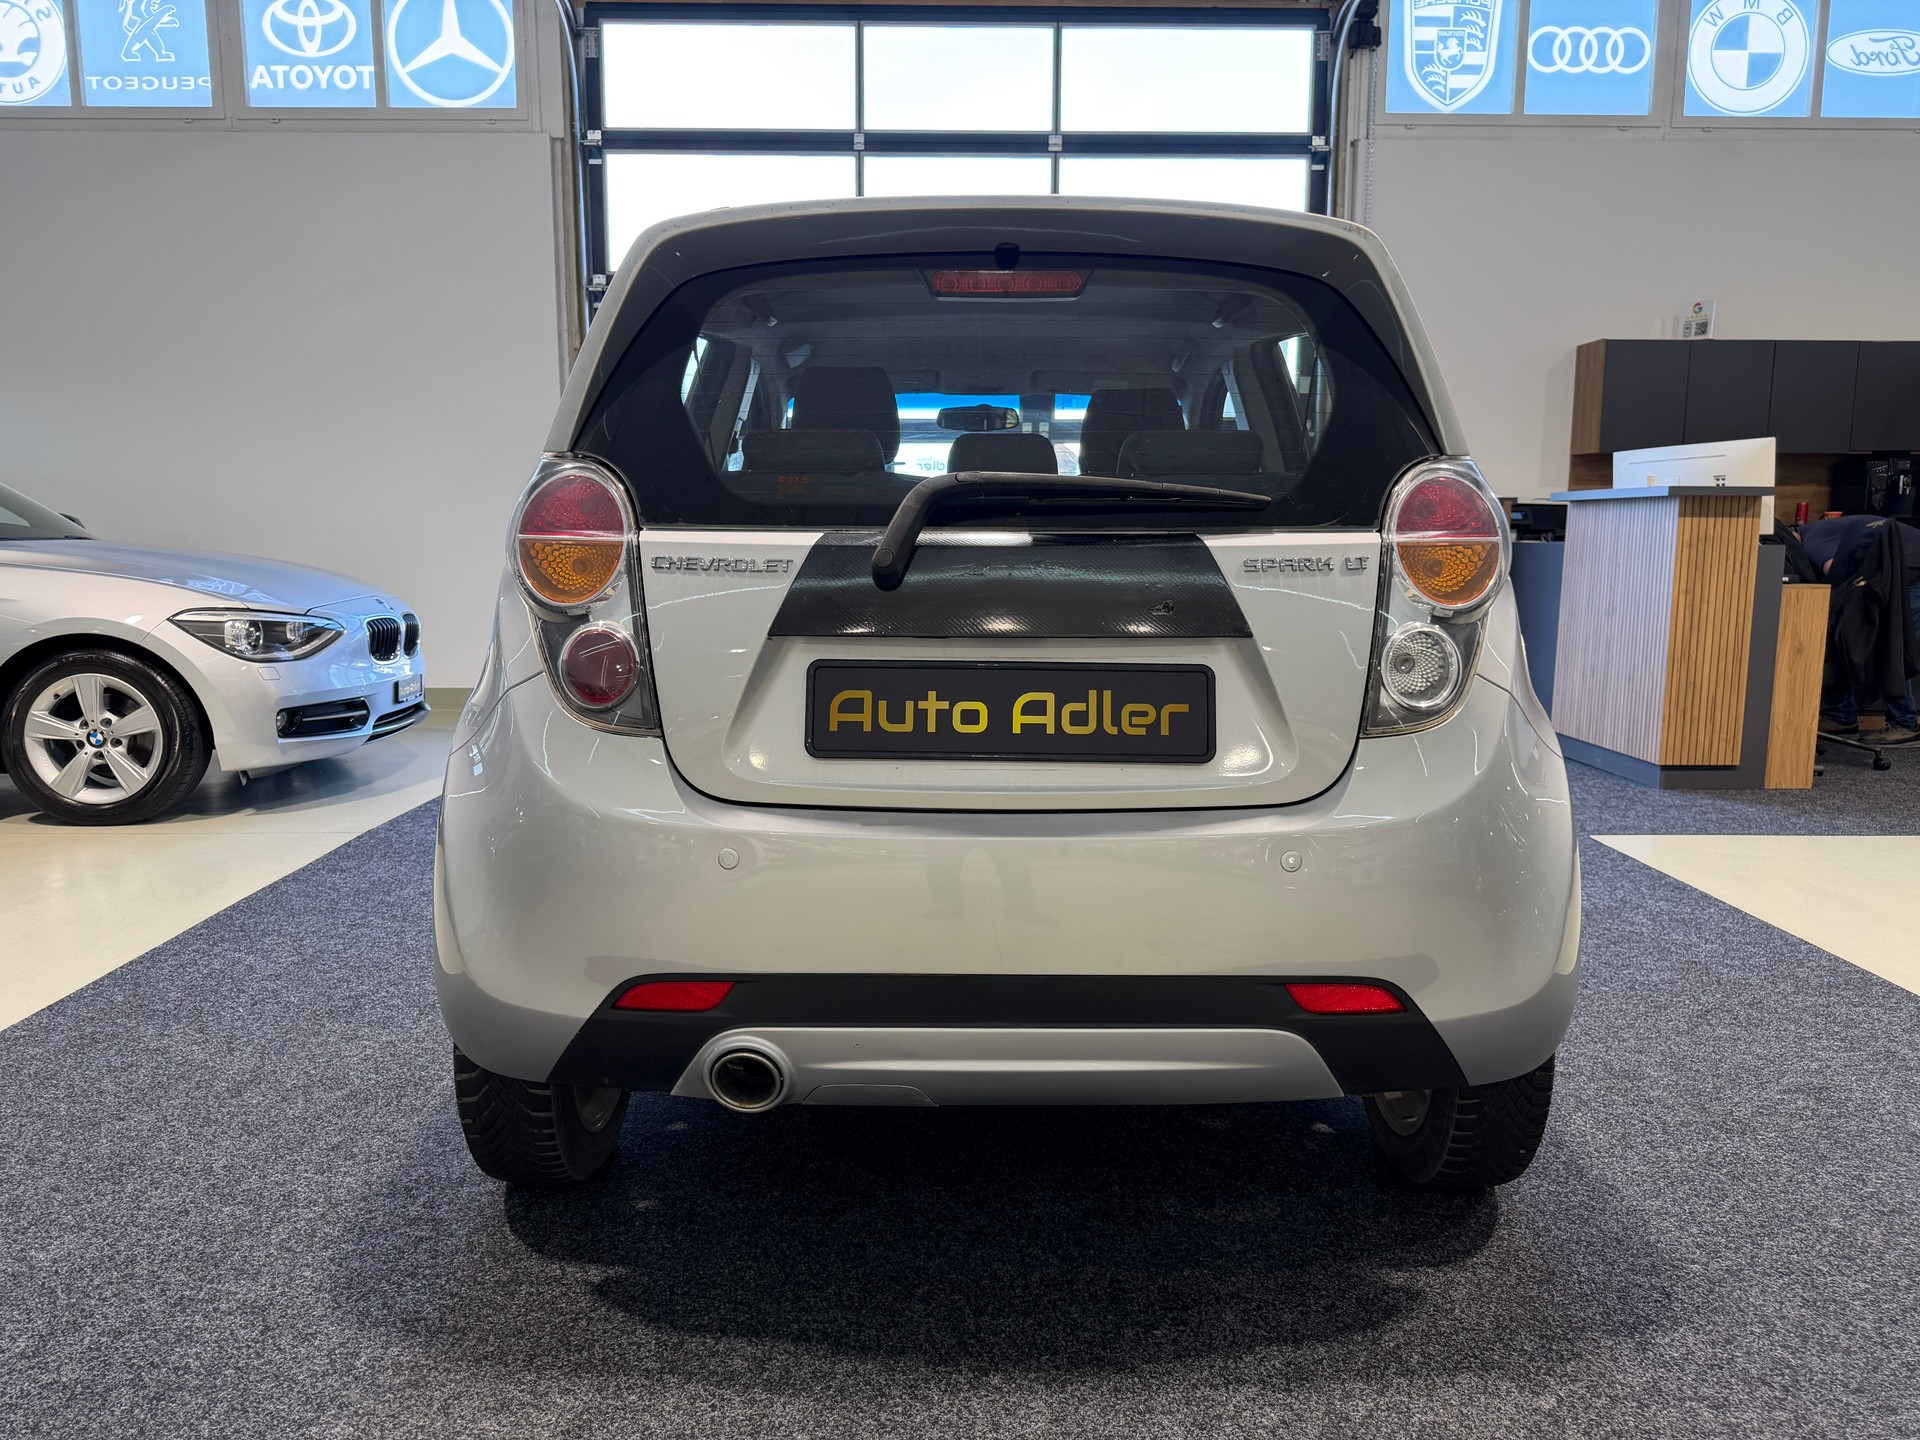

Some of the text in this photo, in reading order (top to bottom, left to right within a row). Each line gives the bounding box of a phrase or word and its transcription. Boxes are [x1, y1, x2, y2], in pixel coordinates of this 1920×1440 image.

[651, 555, 794, 573] CHEVROLET
[1243, 555, 1371, 573] SPARK LT
[829, 690, 1189, 735] Auto Adler
